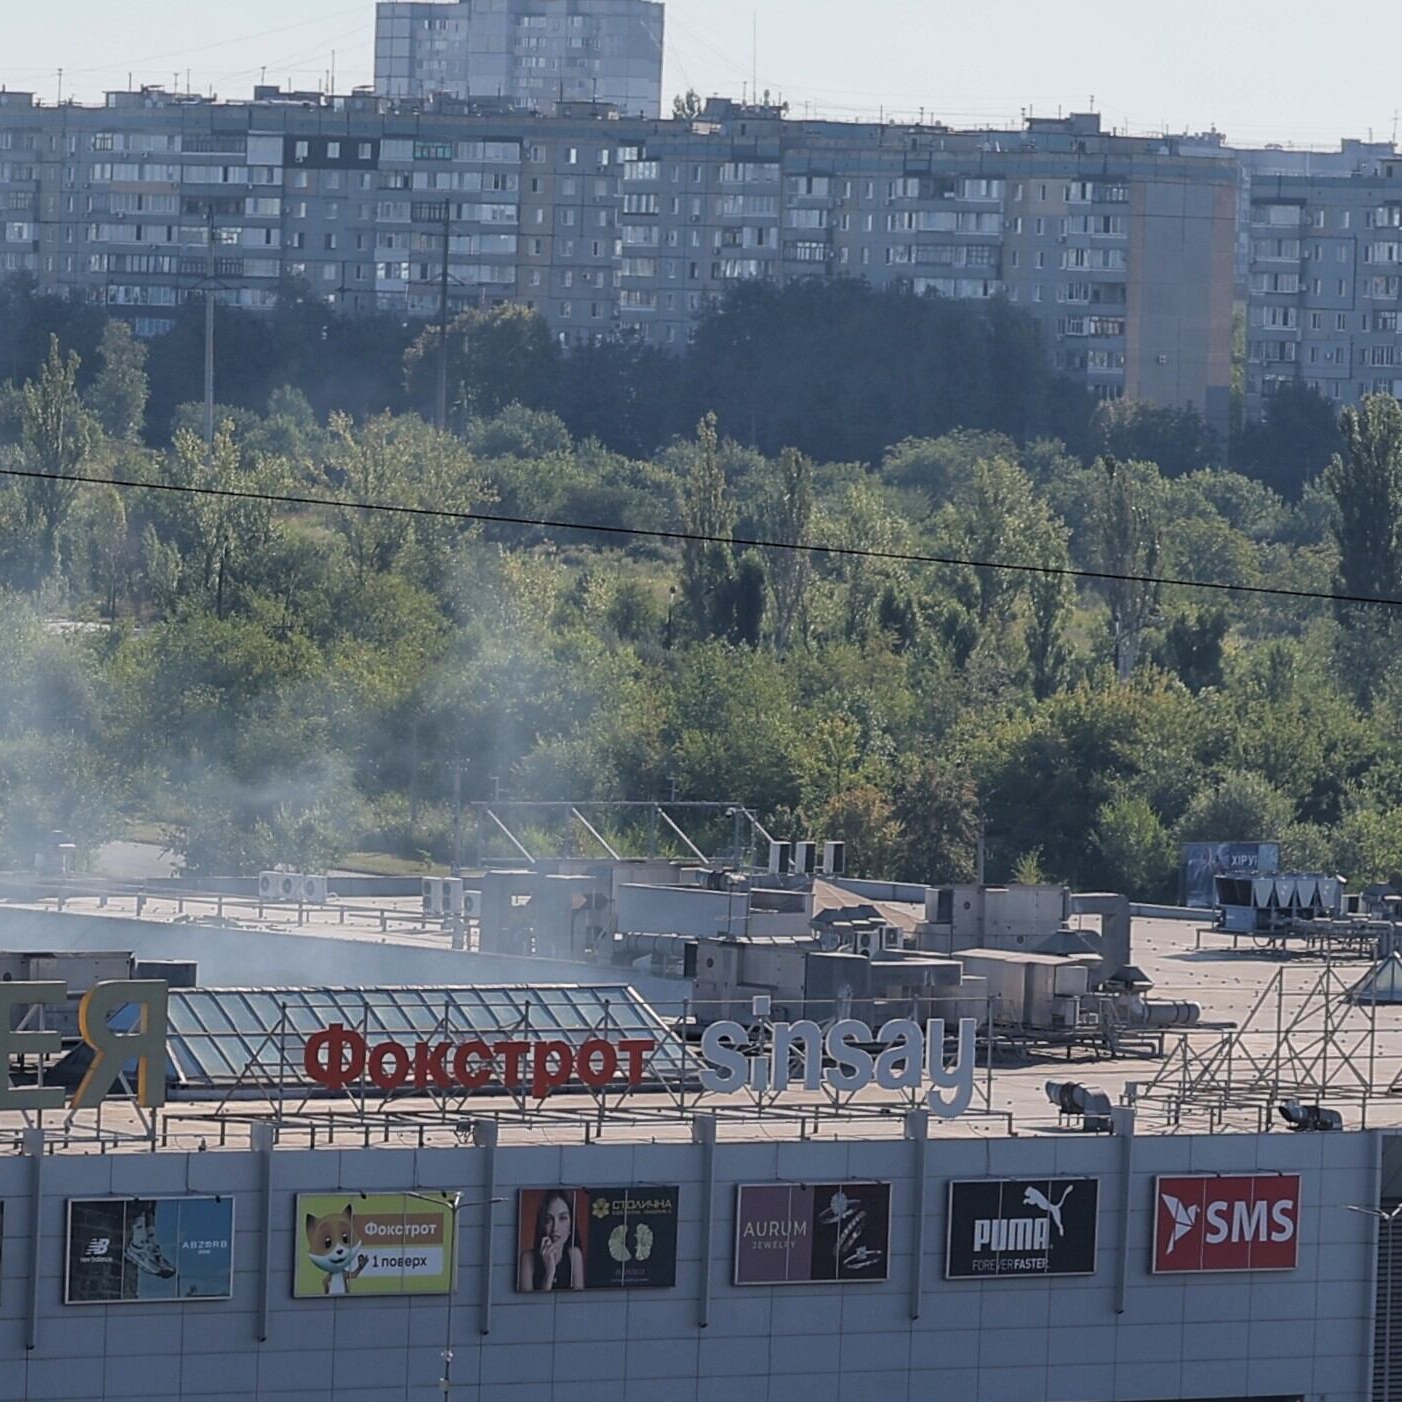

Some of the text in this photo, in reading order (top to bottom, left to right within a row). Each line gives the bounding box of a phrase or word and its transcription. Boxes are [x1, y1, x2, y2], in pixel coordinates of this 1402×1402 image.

[304, 1023, 656, 1099] Фокстрот
[699, 995, 977, 1118] sinsay
[612, 1199, 673, 1210] СТОЛИЧНА
[743, 1220, 807, 1237] AURUM
[1205, 1199, 1294, 1244] SMS
[364, 1222, 437, 1238] Фокстрот
[973, 1217, 1050, 1252] PUMA
[752, 1240, 797, 1250] JEWELRY
[372, 1255, 427, 1271] 1 поверх
[972, 1258, 1014, 1271] FOREVER
